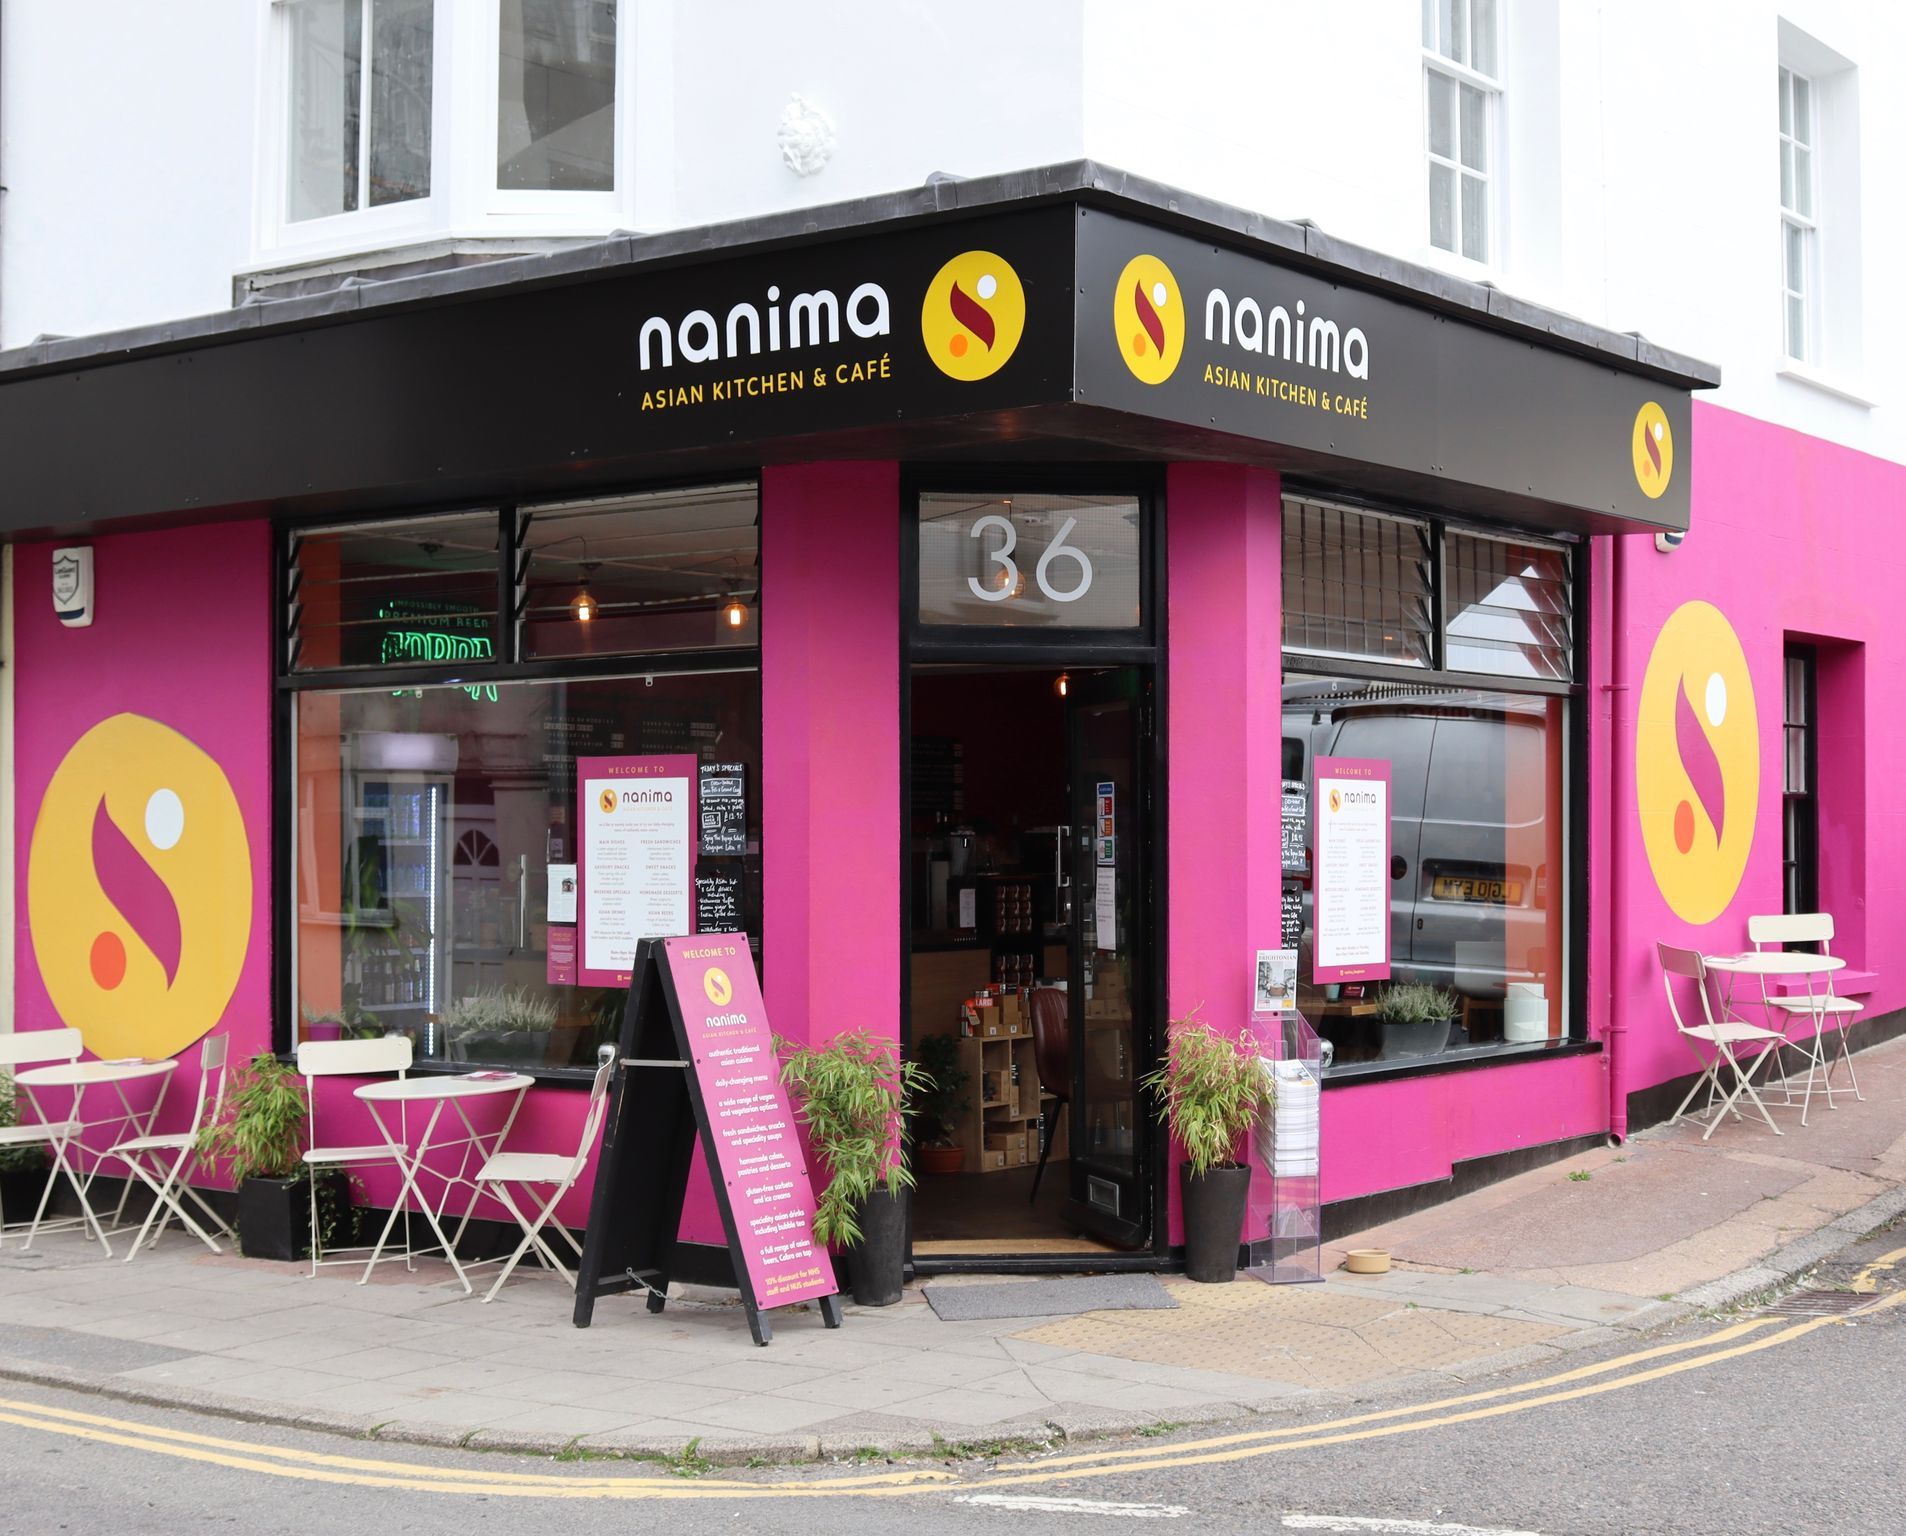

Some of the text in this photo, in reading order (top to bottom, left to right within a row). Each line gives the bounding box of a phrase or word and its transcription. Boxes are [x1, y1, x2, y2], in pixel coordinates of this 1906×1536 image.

[639, 282, 891, 370] nanima
[1205, 288, 1369, 380] nanima
[641, 352, 892, 411] ASIAN KITCHEN & CAFÉ
[1204, 363, 1368, 420] ASIAN KITCHEN & CAFÉ
[608, 766, 648, 774] WELCOME
[1335, 767, 1372, 776] WELCOME TO
[622, 788, 673, 803] nanima
[1344, 790, 1377, 804] nanima
[683, 947, 736, 959] WELCOME TO
[706, 1013, 747, 1028] nanima
[718, 1029, 739, 1037] KITCHEN
[708, 1044, 761, 1058] authentic traditional
[720, 1056, 753, 1066] asian cuisine
[715, 1074, 768, 1087] daily-changing menu
[723, 1098, 736, 1107] wide
[736, 1097, 752, 1107] range
[752, 1095, 759, 1103] of
[759, 1094, 775, 1103] vegan
[720, 1103, 778, 1117] and vegetarian options
[722, 1121, 785, 1137] fresh sandwiches, snacks
[731, 1133, 782, 1147] and speciality soups
[739, 1154, 768, 1165] homemade
[737, 1161, 791, 1178] pastries and desserts
[745, 1181, 794, 1197] gluten-free sorbets
[753, 1196, 764, 1204] and
[772, 1192, 791, 1201] creams
[750, 1209, 804, 1227] speciality asian drinks
[754, 1225, 777, 1236] including
[778, 1222, 795, 1231] bubble
[764, 1245, 773, 1255] full
[774, 1244, 789, 1254] range
[789, 1241, 796, 1249] of
[796, 1239, 810, 1248] asian
[779, 1253, 795, 1262] Cobra
[803, 1249, 812, 1259] tap
[766, 1267, 820, 1285] 10% discount for NHS
[766, 1278, 824, 1296] staff and NUS students
